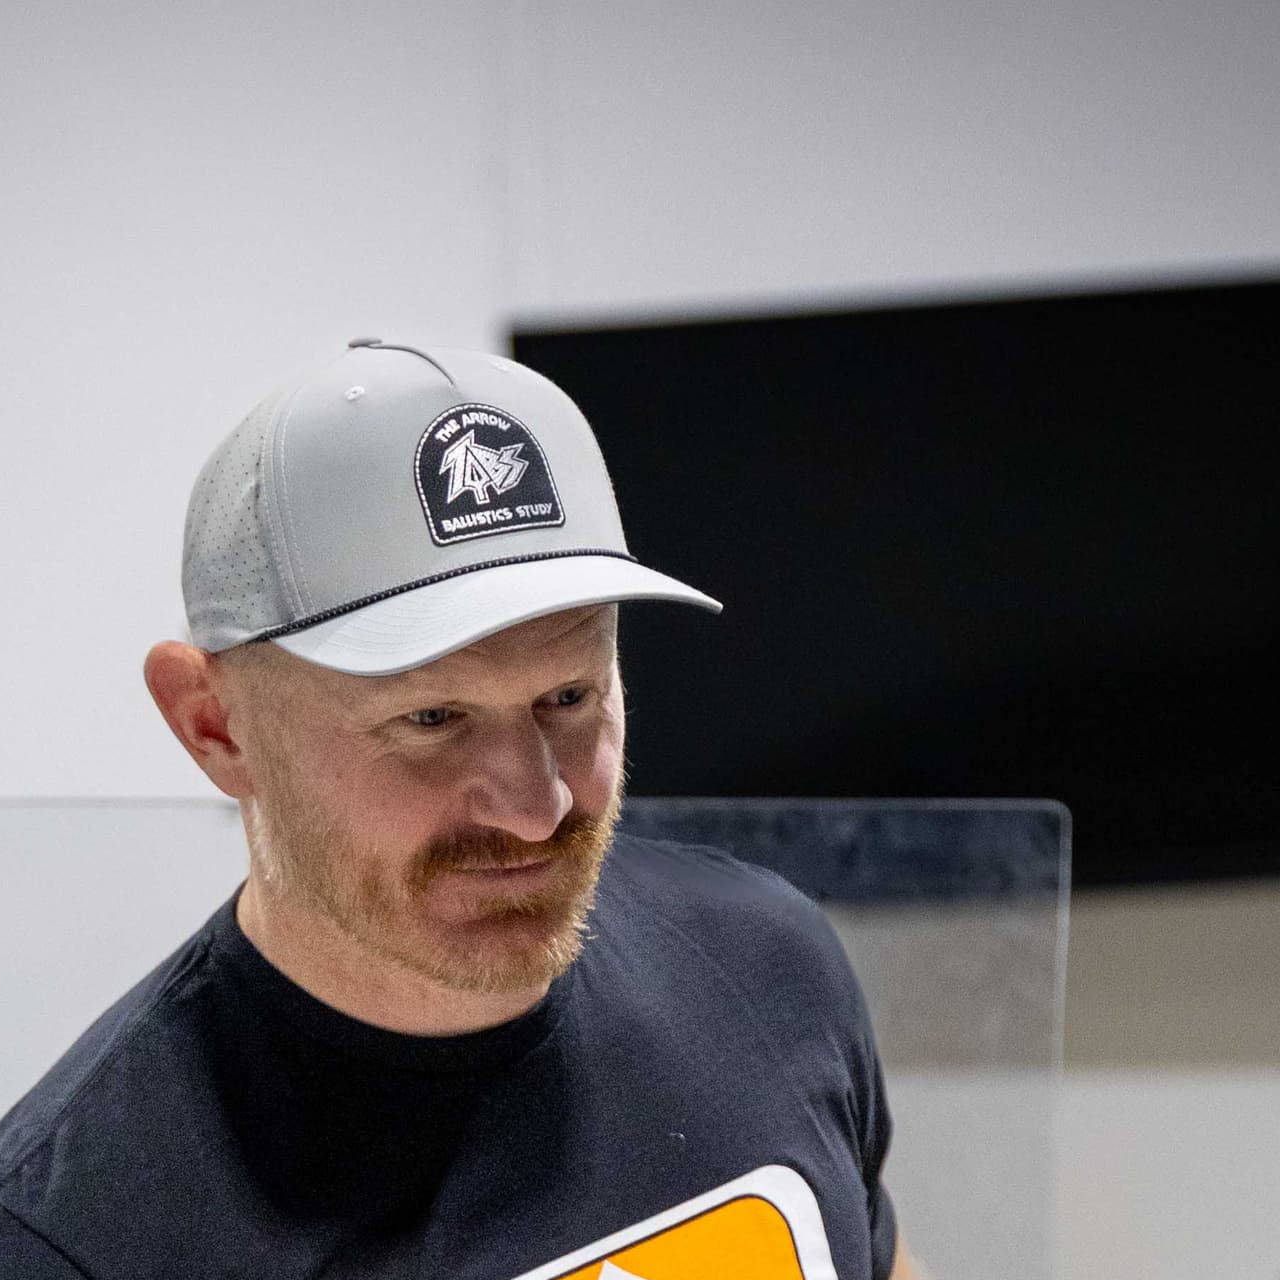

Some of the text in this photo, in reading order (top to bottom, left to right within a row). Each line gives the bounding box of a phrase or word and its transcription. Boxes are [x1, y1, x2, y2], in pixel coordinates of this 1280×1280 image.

[435, 412, 511, 442] THE ARROW
[441, 502, 553, 532] BALLISTICS STUDY
